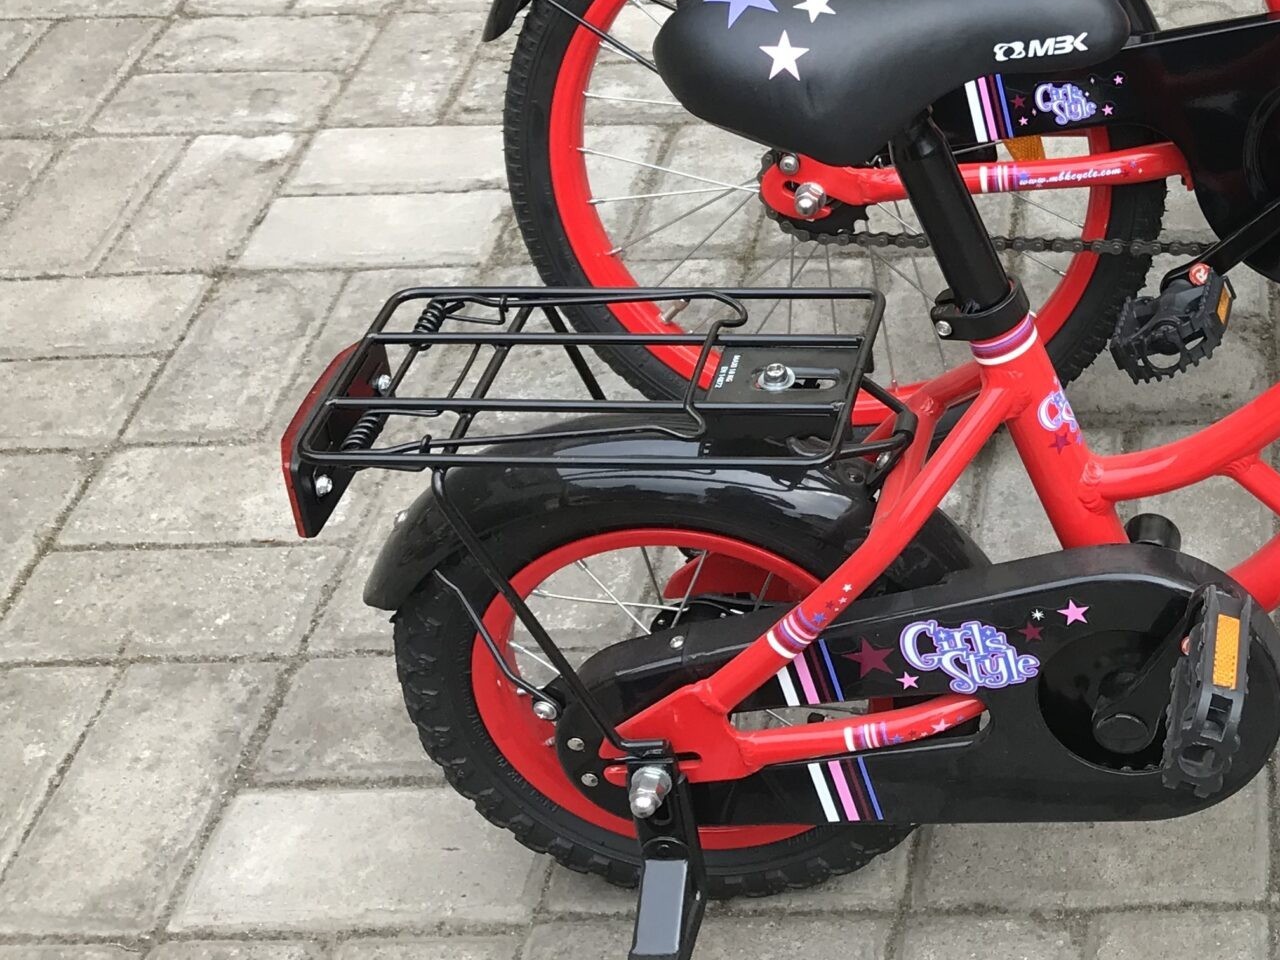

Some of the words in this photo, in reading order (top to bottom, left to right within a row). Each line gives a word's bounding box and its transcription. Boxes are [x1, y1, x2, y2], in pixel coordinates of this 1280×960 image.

[1027, 32, 1088, 57] MBK
[1051, 96, 1097, 125] Style
[901, 620, 1007, 671] Girls
[941, 646, 1040, 693] Style
